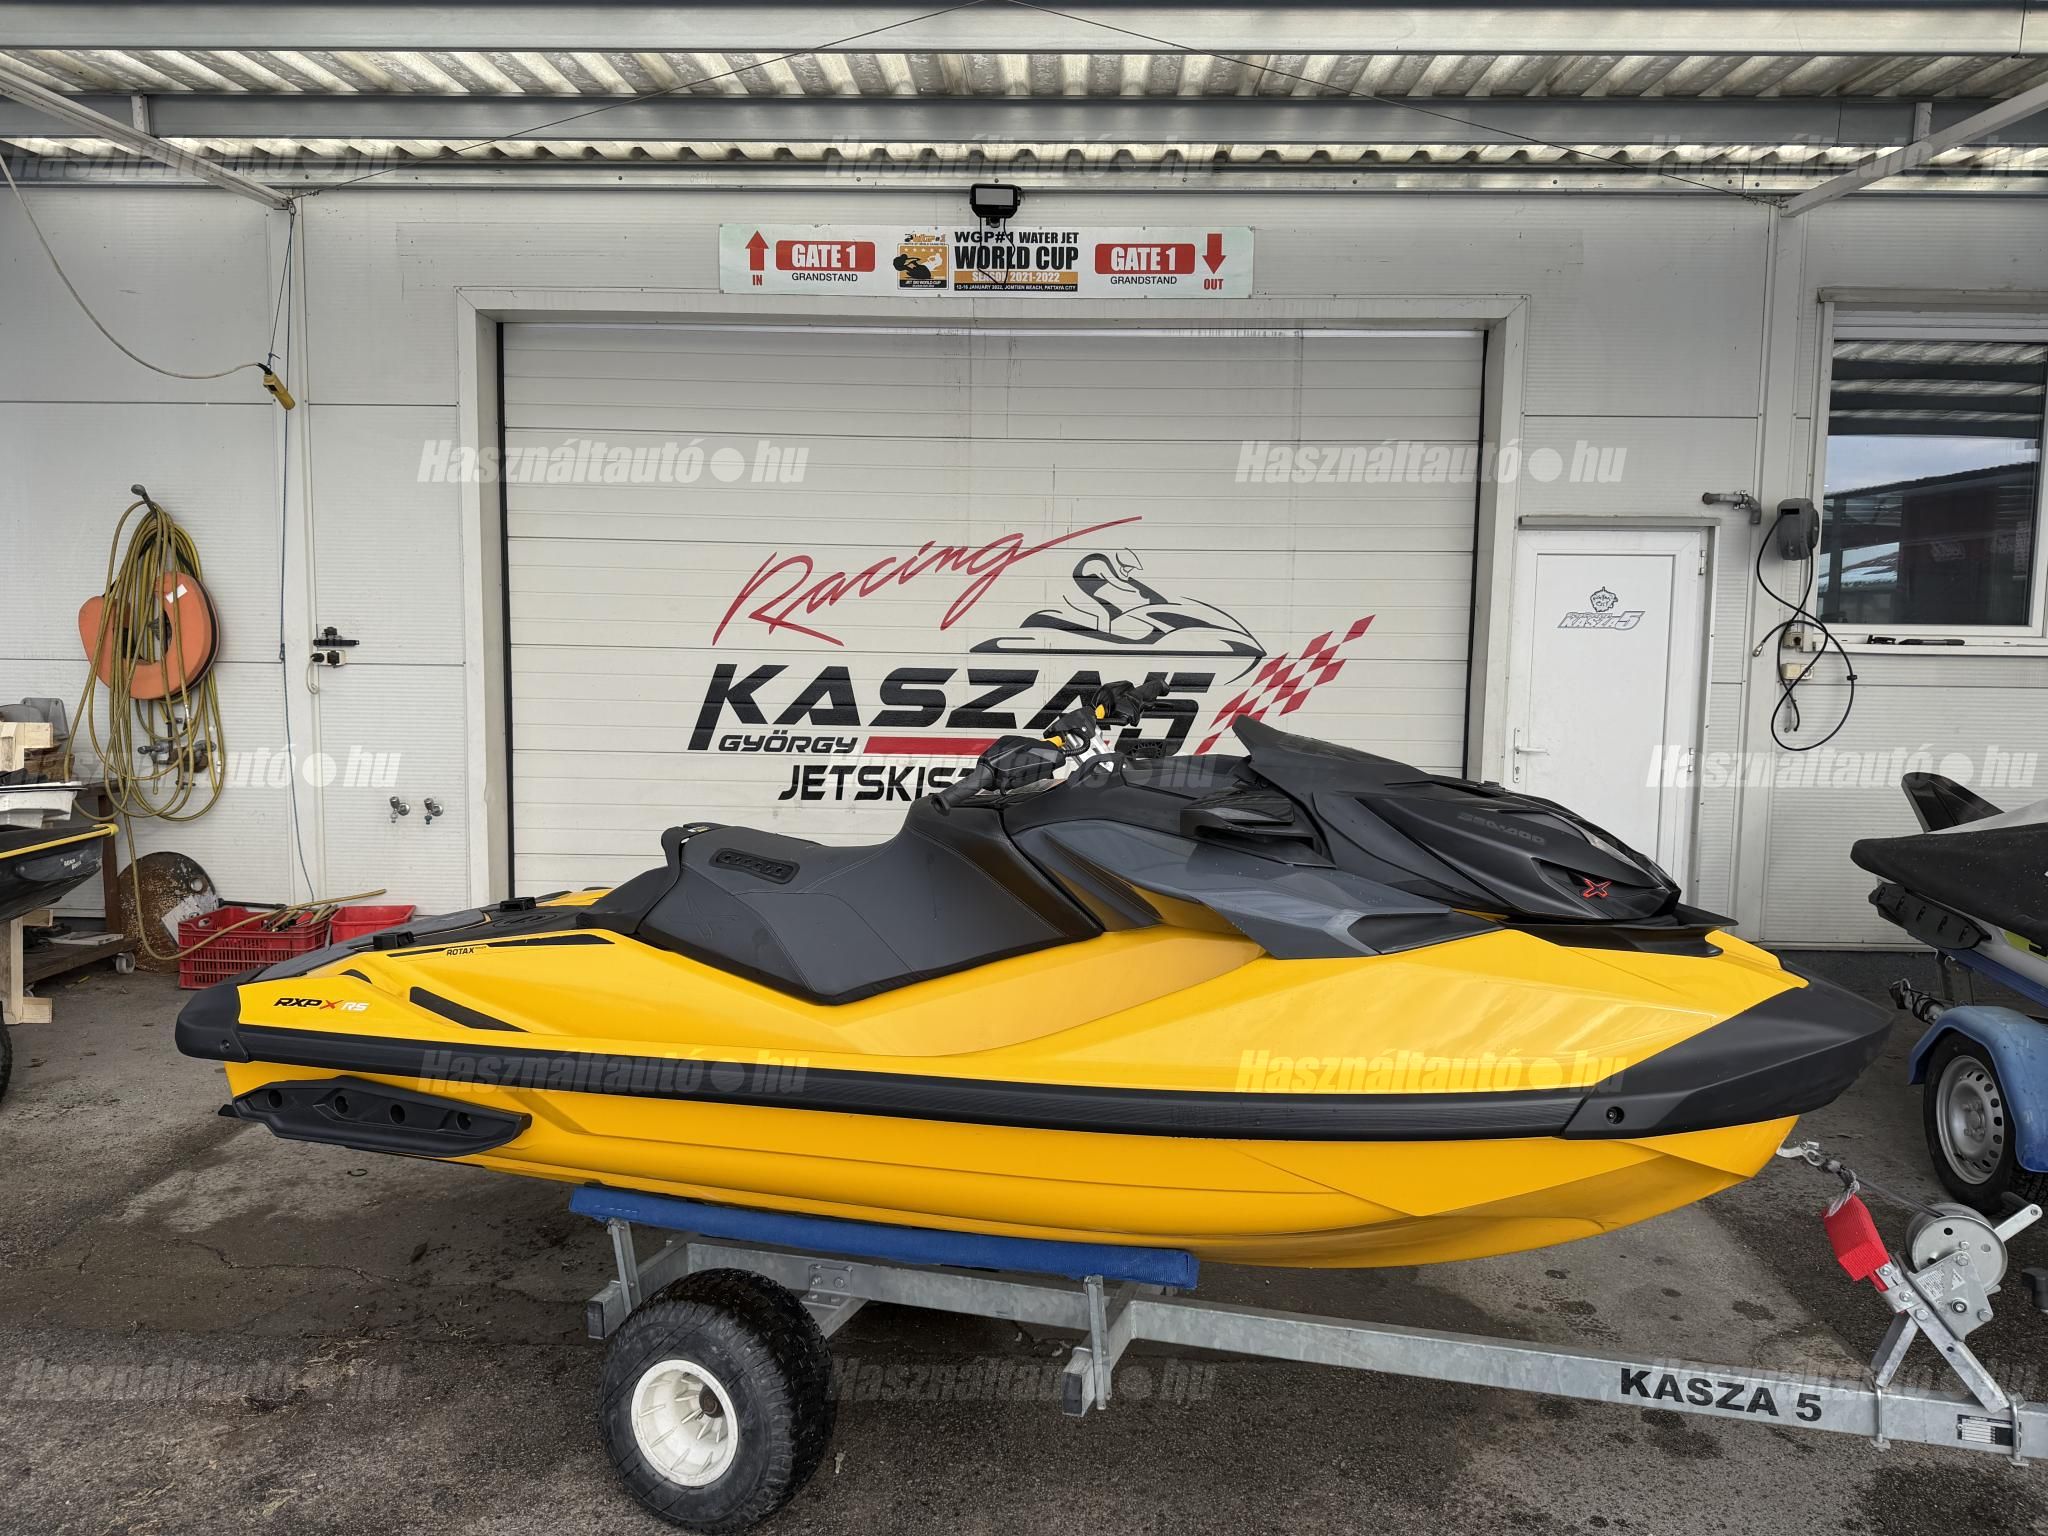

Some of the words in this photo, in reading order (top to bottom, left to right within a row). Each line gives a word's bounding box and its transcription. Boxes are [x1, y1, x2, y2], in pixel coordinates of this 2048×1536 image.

[1018, 232, 1059, 244] WATER
[1061, 232, 1079, 244] JET
[791, 243, 842, 268] GATE
[846, 244, 856, 269] 1
[954, 245, 1031, 270] WORLD
[1035, 246, 1079, 270] CUP
[1110, 246, 1161, 271] GATE
[1165, 247, 1176, 271] 1
[752, 274, 763, 286] IN
[791, 272, 858, 282] GRANDSTAND
[1009, 271, 1060, 283] 2021-2022
[1110, 275, 1177, 285] GRANDSTAND
[1203, 278, 1224, 290] OUT
[711, 515, 1142, 647] Racing
[717, 729, 859, 754] GYÖRGY
[778, 763, 977, 801] JETSKIS
[446, 946, 475, 957] ROTAX
[1620, 1367, 1779, 1417] KASZA
[1795, 1392, 1822, 1422] 5
